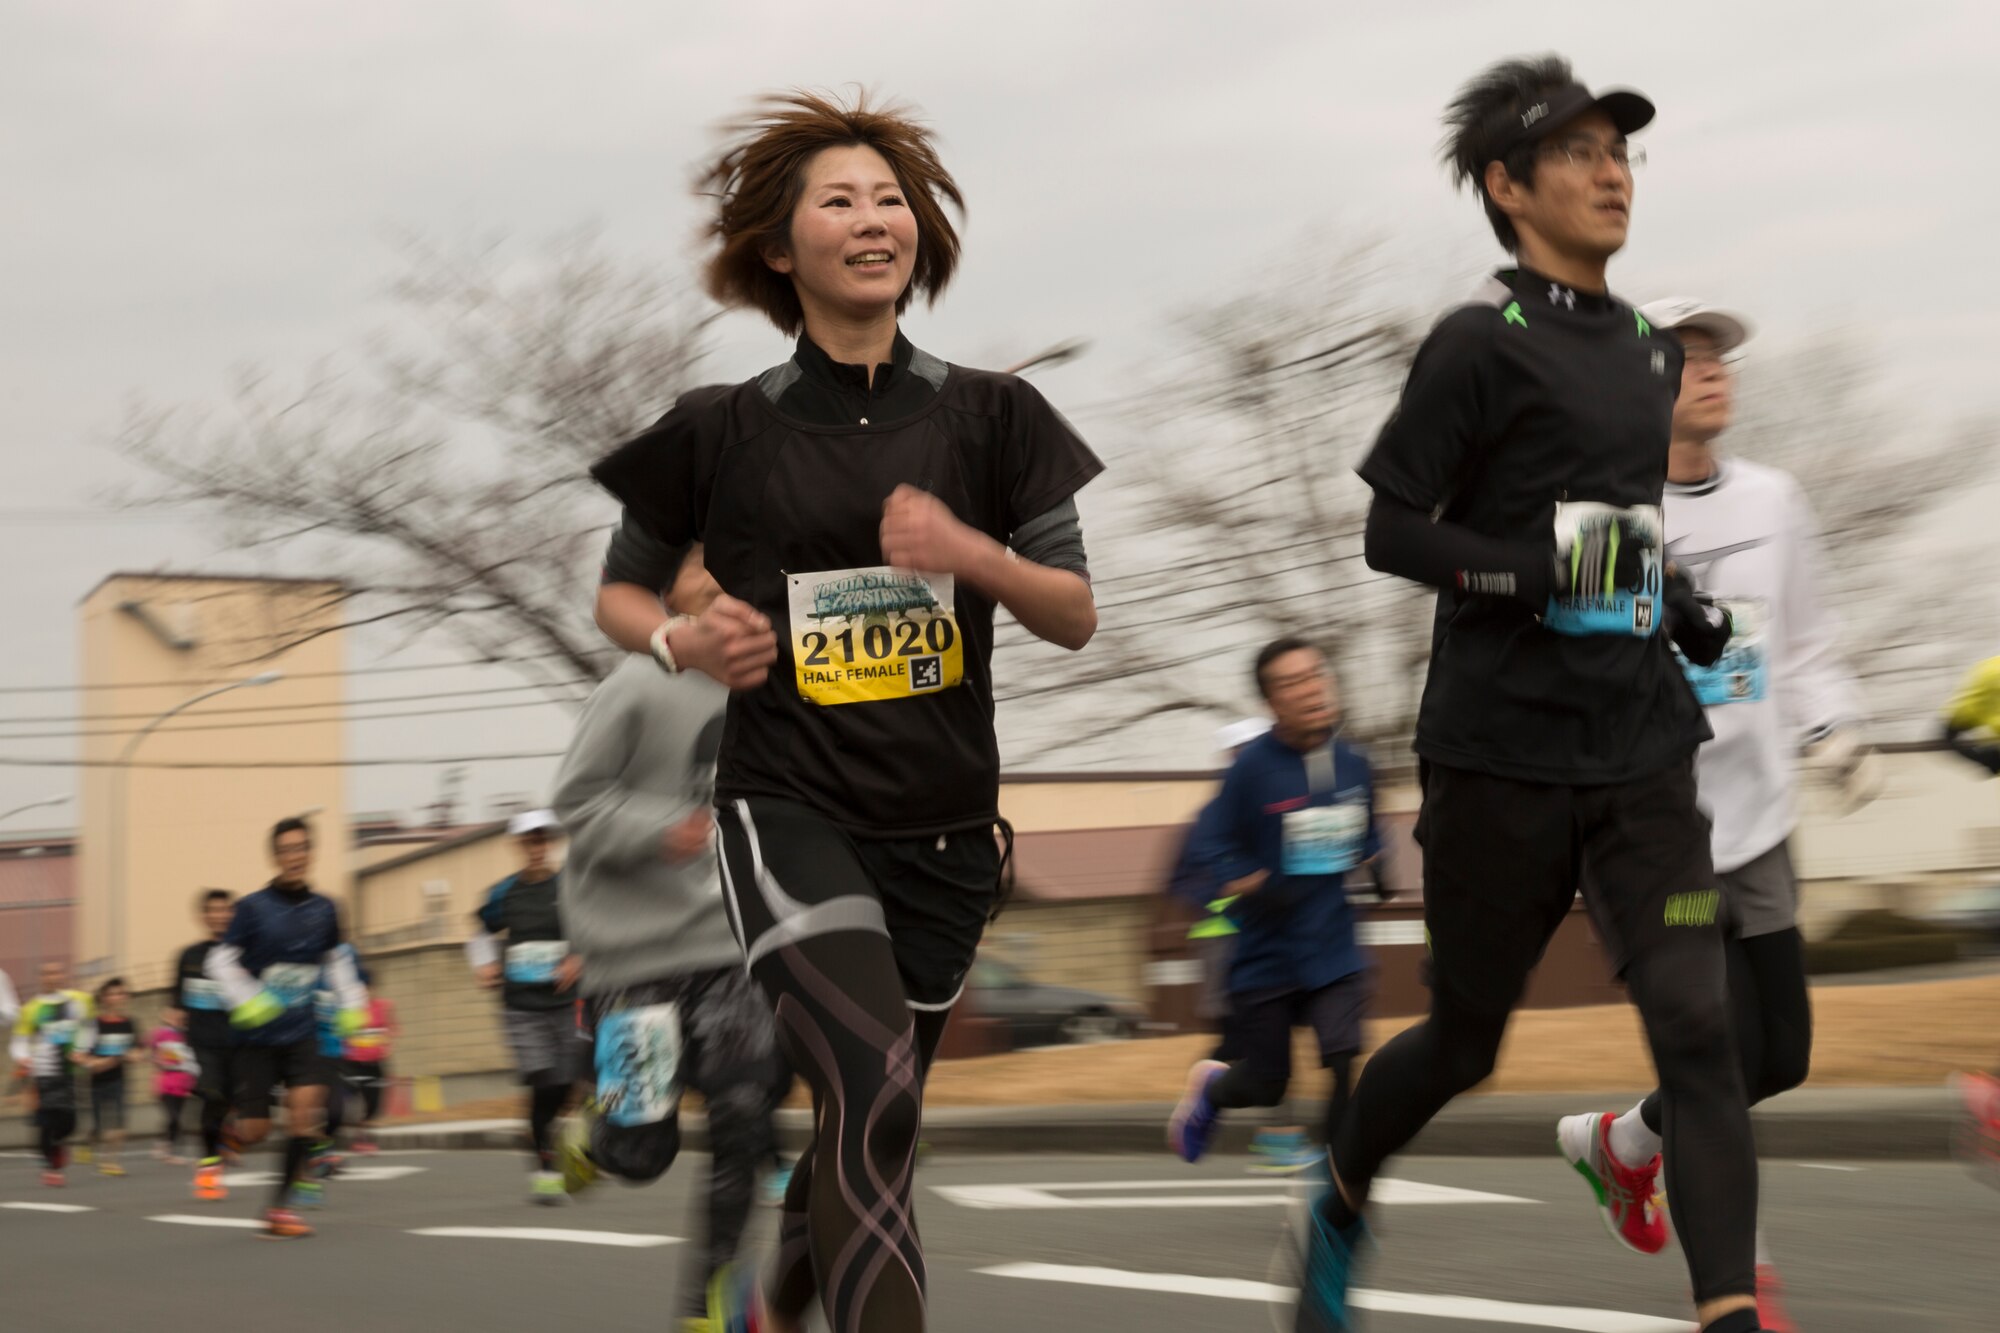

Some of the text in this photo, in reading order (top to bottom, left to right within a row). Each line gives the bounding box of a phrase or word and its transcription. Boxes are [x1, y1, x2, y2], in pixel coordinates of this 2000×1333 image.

[813, 574, 866, 600] YOKOTA
[1595, 600, 1626, 614] MALE
[802, 618, 954, 666] 21020
[803, 663, 906, 684] HALF FEMALE
